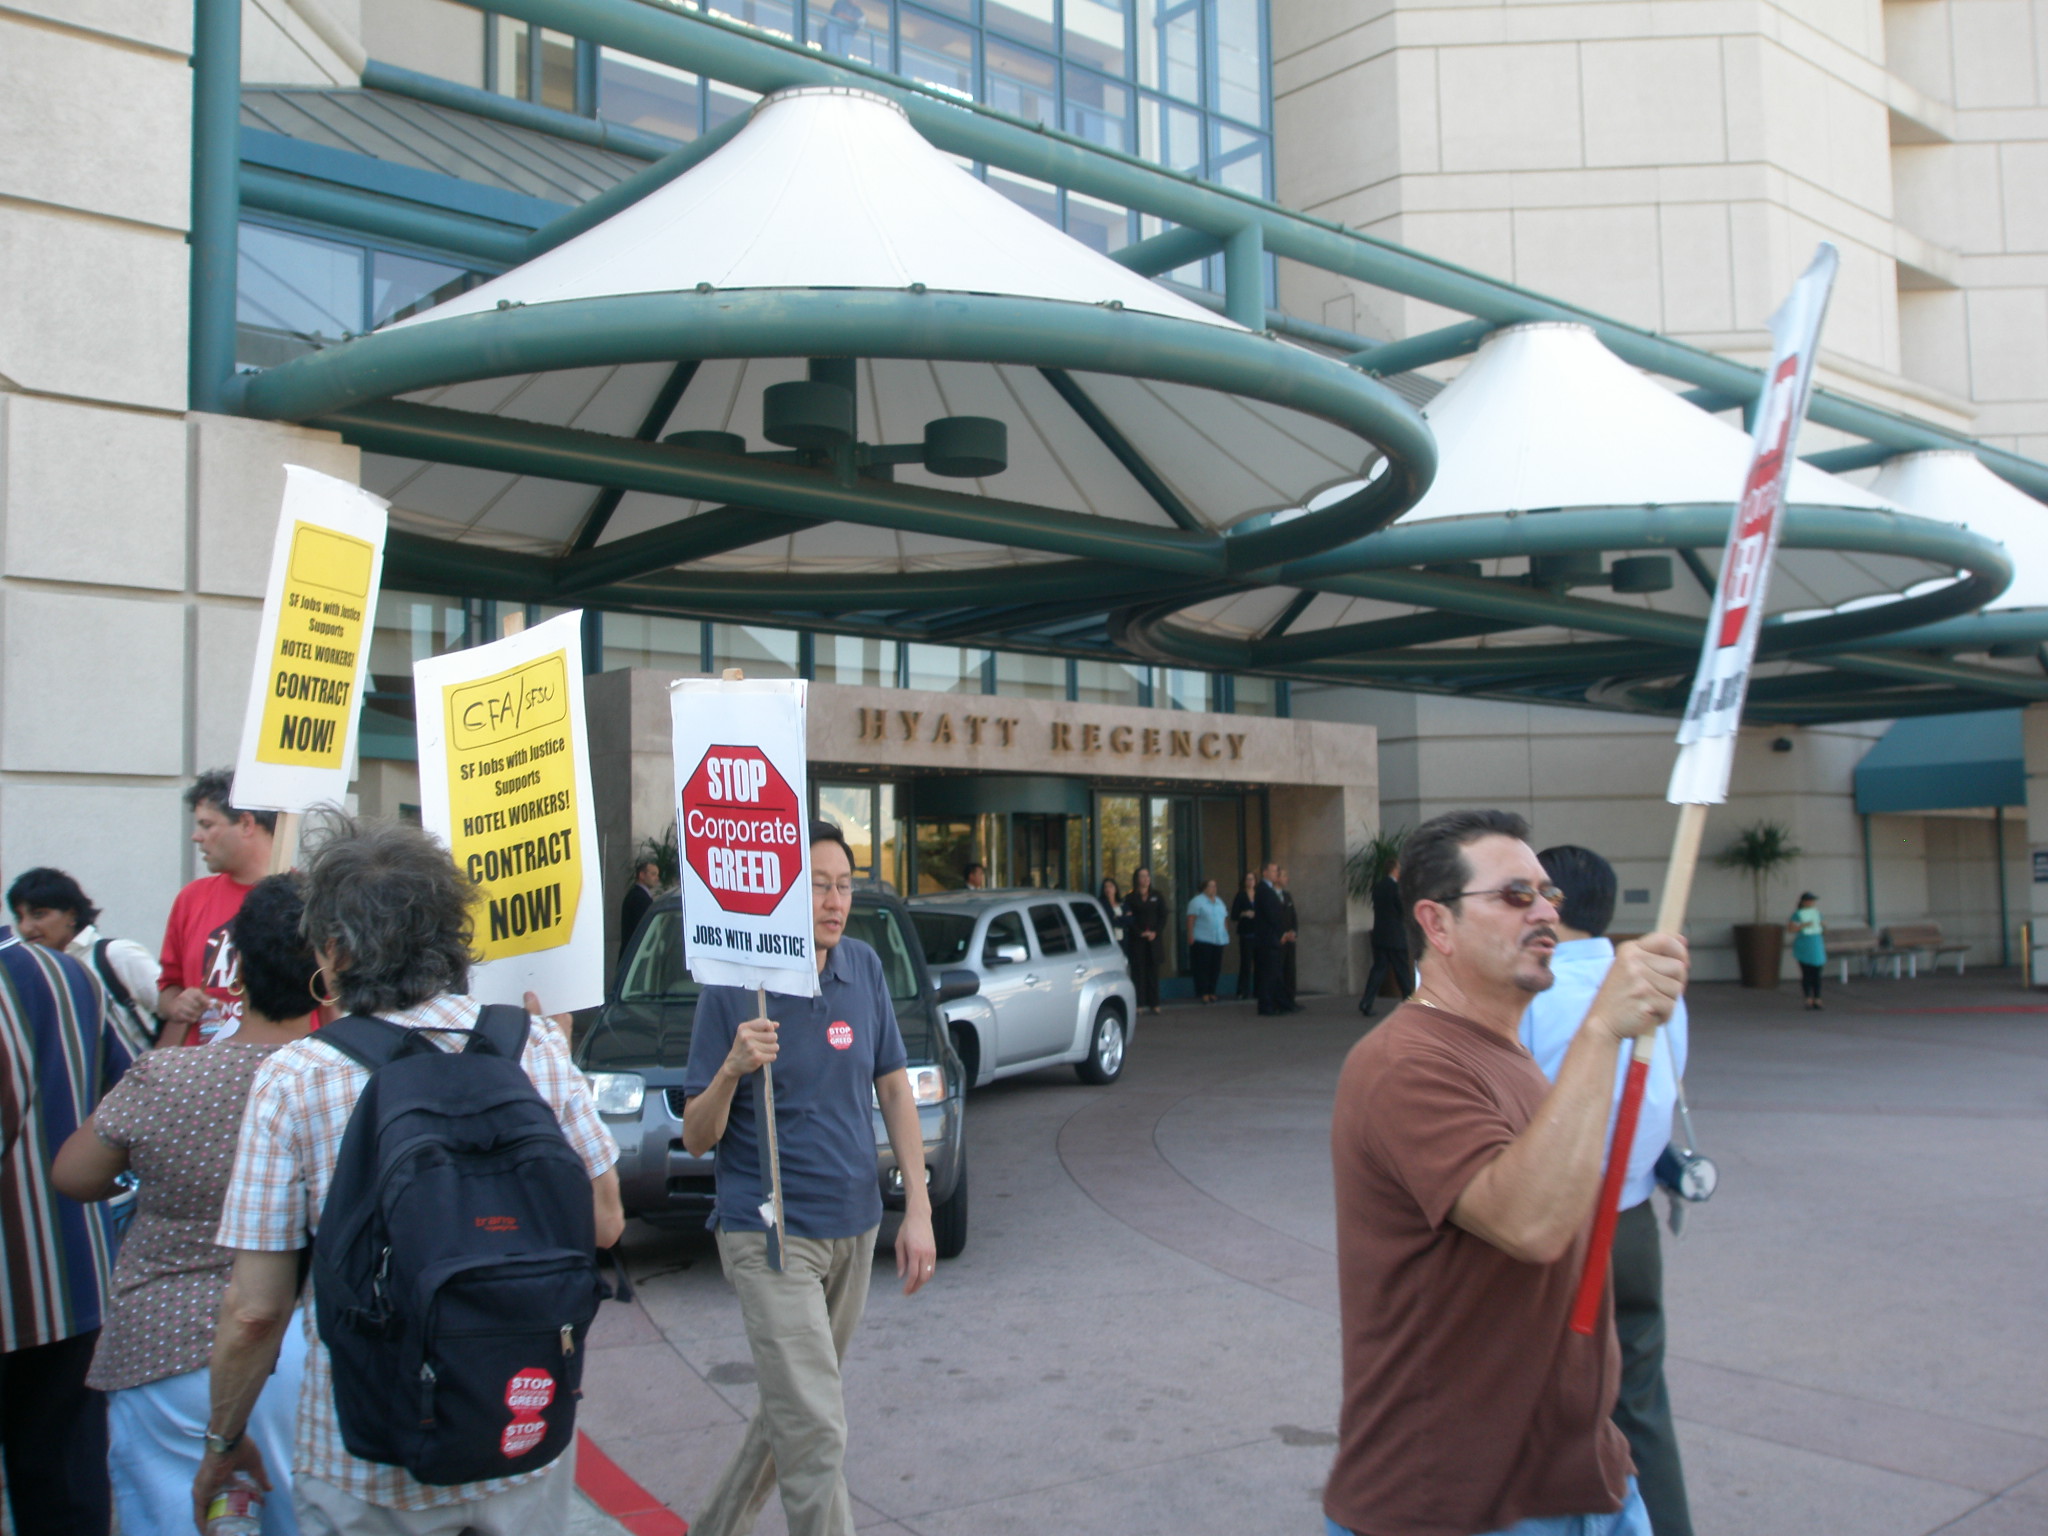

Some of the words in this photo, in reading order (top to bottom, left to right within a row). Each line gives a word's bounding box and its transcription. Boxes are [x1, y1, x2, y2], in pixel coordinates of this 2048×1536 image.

[289, 593, 300, 607] SF
[301, 597, 321, 612] Jobs
[323, 602, 340, 616] with
[341, 606, 361, 622] Justice
[309, 618, 344, 637] Supports
[281, 639, 312, 660] HOTEL
[315, 645, 355, 668] WORKERS!
[276, 671, 350, 706] CONTRACT
[279, 715, 336, 753] NOW!
[858, 707, 1019, 747] HYATT
[1051, 721, 1247, 760] REGENCY
[461, 762, 475, 780] SF
[479, 757, 504, 779] Jobs
[506, 748, 527, 768] with
[530, 737, 565, 763] Justice
[495, 769, 541, 796] Supports
[707, 757, 767, 803] STOP
[464, 810, 506, 837] HOTEL
[508, 790, 570, 827] WORKERS!
[688, 810, 797, 845] Corporate
[467, 828, 572, 884] CONTRACT
[707, 846, 781, 894] GREED
[489, 883, 562, 942] NOW!
[693, 925, 722, 946] JOBS
[725, 928, 751, 952] WITH
[756, 933, 805, 958] JUSTICE
[829, 1026, 851, 1035] STOP
[508, 1395, 549, 1406] GREED
[511, 1377, 553, 1390] STOP
[504, 1421, 545, 1437] STOP
